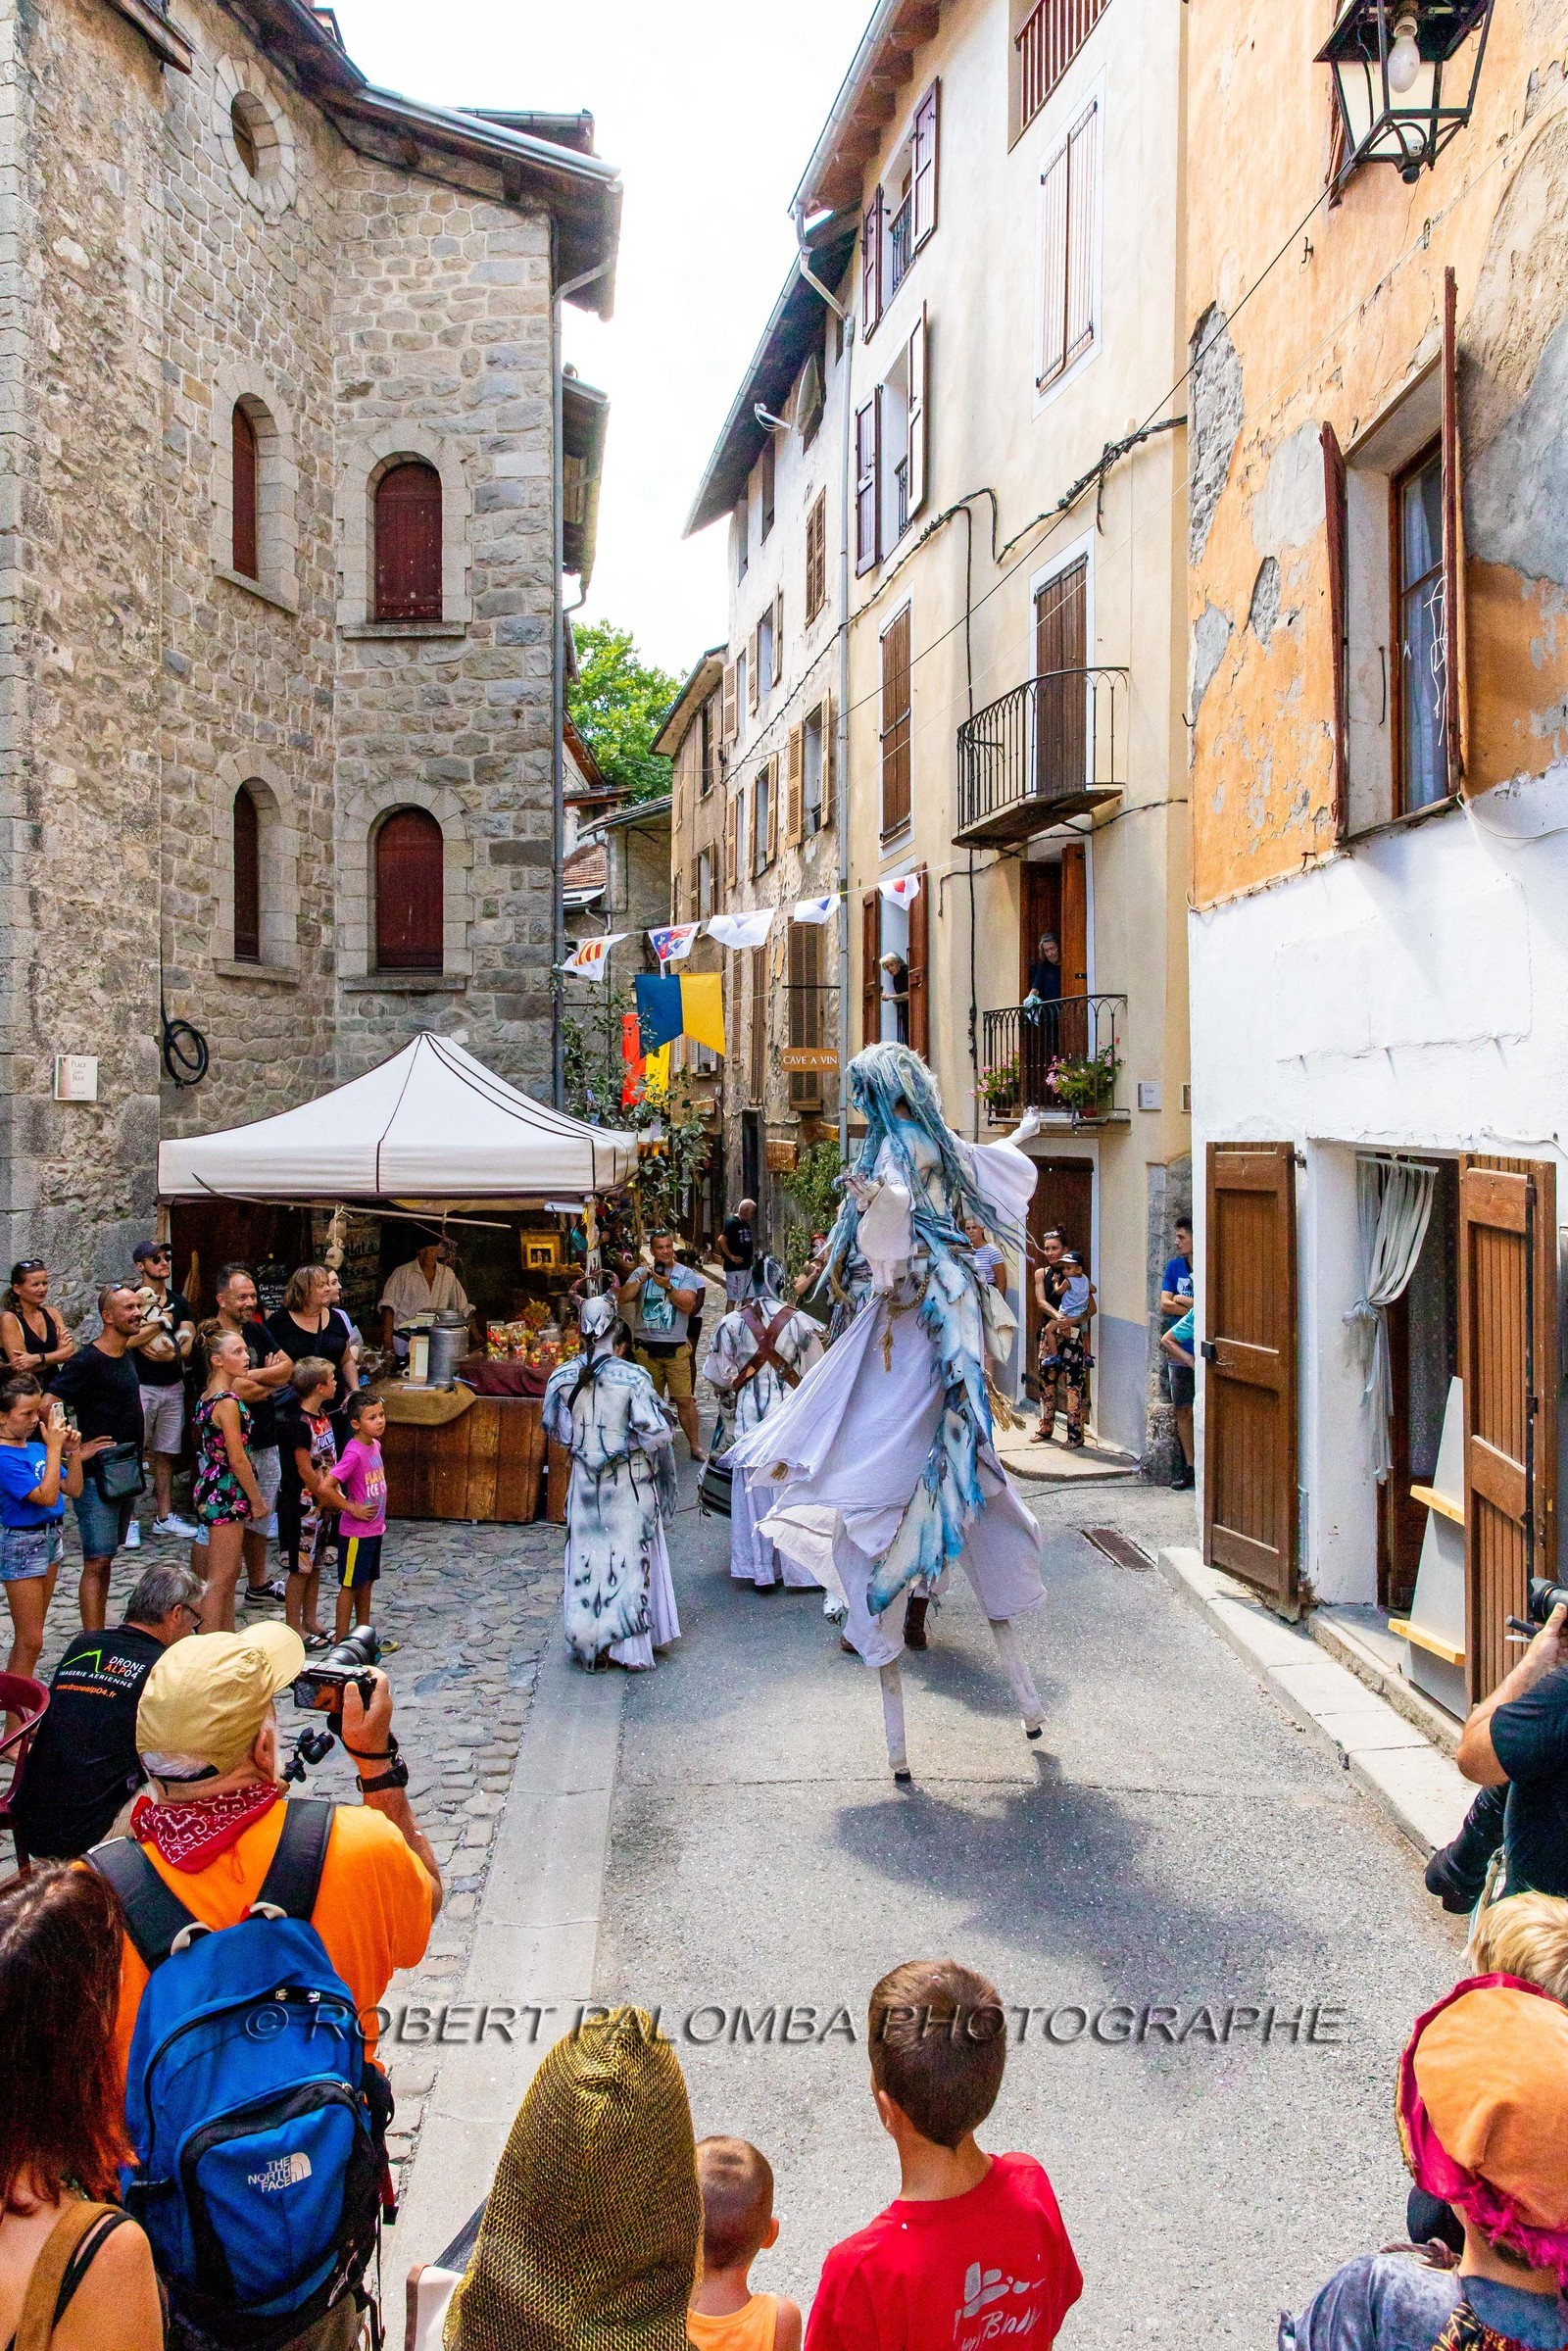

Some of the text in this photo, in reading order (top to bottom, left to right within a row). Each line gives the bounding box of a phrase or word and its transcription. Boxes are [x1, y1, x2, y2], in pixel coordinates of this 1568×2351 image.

[783, 1055, 838, 1065] CAVE A VIN
[109, 1655, 146, 1674] DRONE
[88, 1673, 134, 1689] AERIENNE
[266, 2155, 291, 2172] THE
[247, 2165, 292, 2185] NORTH
[261, 2176, 293, 2193] FACE
